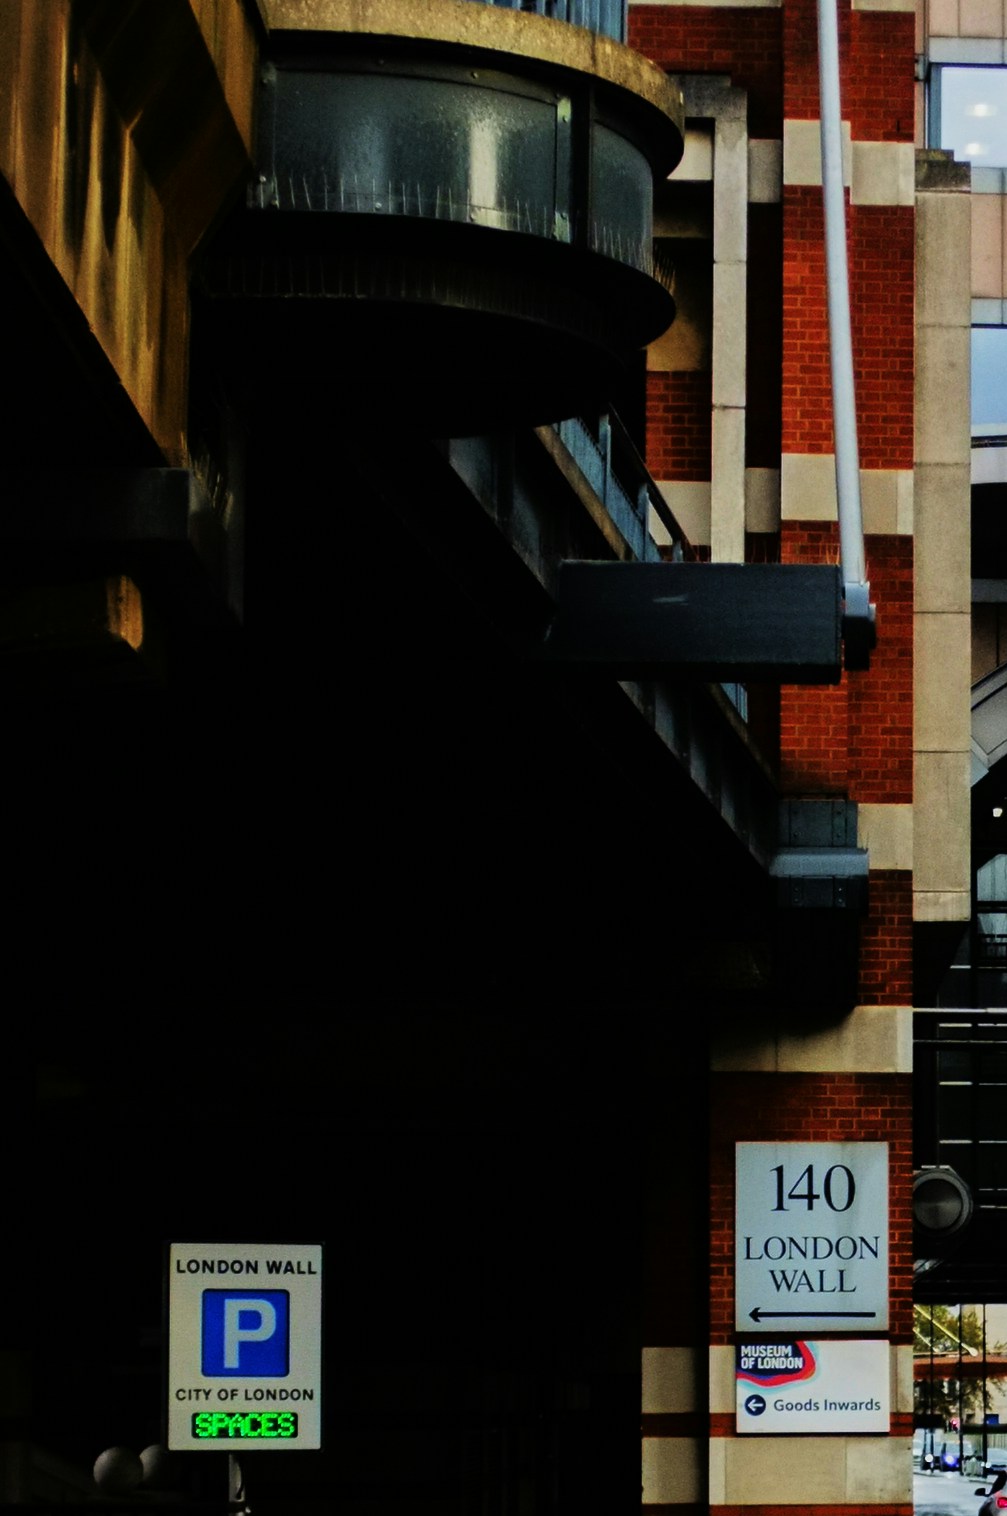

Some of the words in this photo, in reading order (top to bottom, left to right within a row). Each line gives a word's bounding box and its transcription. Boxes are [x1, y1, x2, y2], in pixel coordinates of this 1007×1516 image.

[769, 1164, 856, 1212] 140
[743, 1235, 880, 1261] LONDON
[176, 1259, 258, 1275] LONDON
[266, 1260, 318, 1275] WALL
[769, 1269, 857, 1293] WALL
[224, 1298, 277, 1369] P
[741, 1345, 792, 1357] MUSEUM
[741, 1357, 755, 1369] OF
[757, 1357, 803, 1369] LONDON
[175, 1389, 213, 1401] CITY
[217, 1389, 239, 1401] OF
[244, 1389, 314, 1401] LONDON
[773, 1399, 820, 1412] Goods
[824, 1399, 881, 1411] Inwards
[195, 1413, 295, 1437] SPACES
